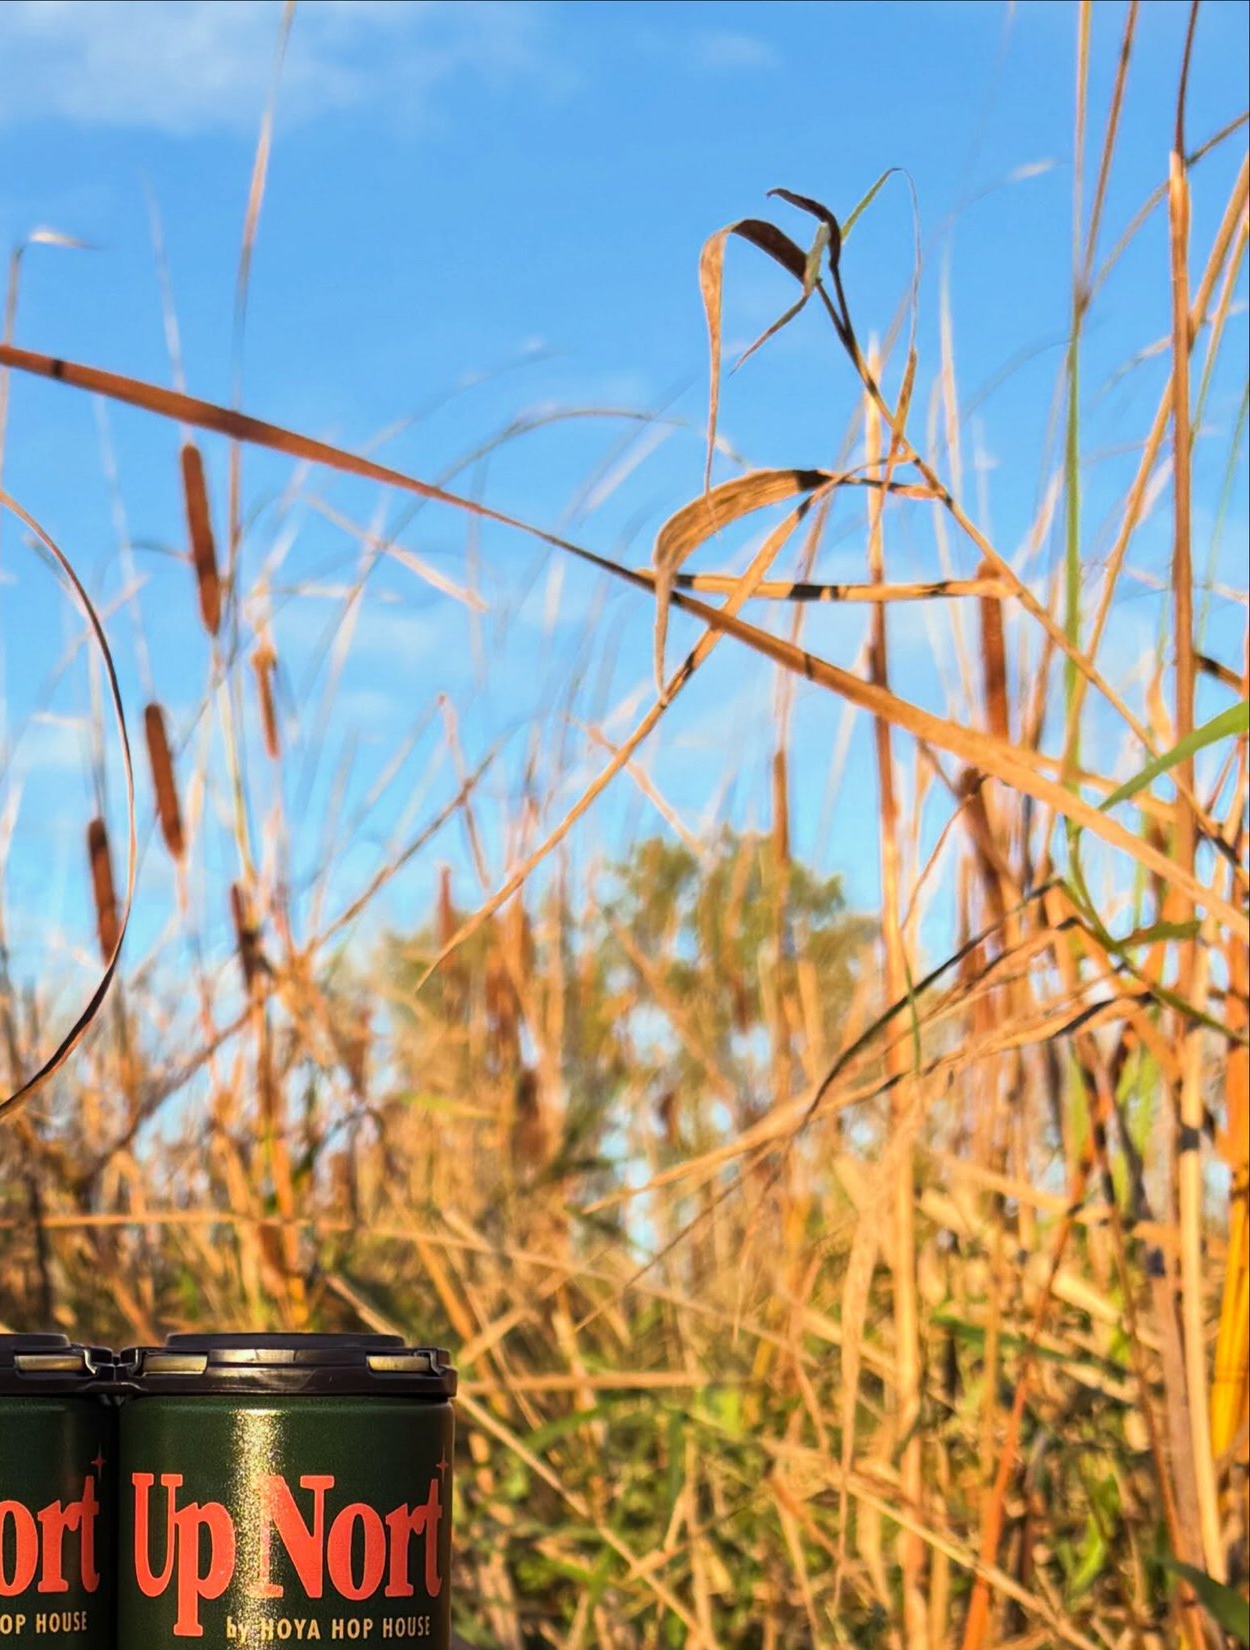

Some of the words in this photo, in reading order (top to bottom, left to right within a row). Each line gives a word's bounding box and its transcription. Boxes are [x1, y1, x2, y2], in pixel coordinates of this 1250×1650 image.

[132, 1472, 236, 1637] Up
[36, 1611, 87, 1633] HOUSE
[261, 1618, 321, 1640] HOYA
[332, 1618, 373, 1639] HOP
[383, 1616, 430, 1638] HOUSE
